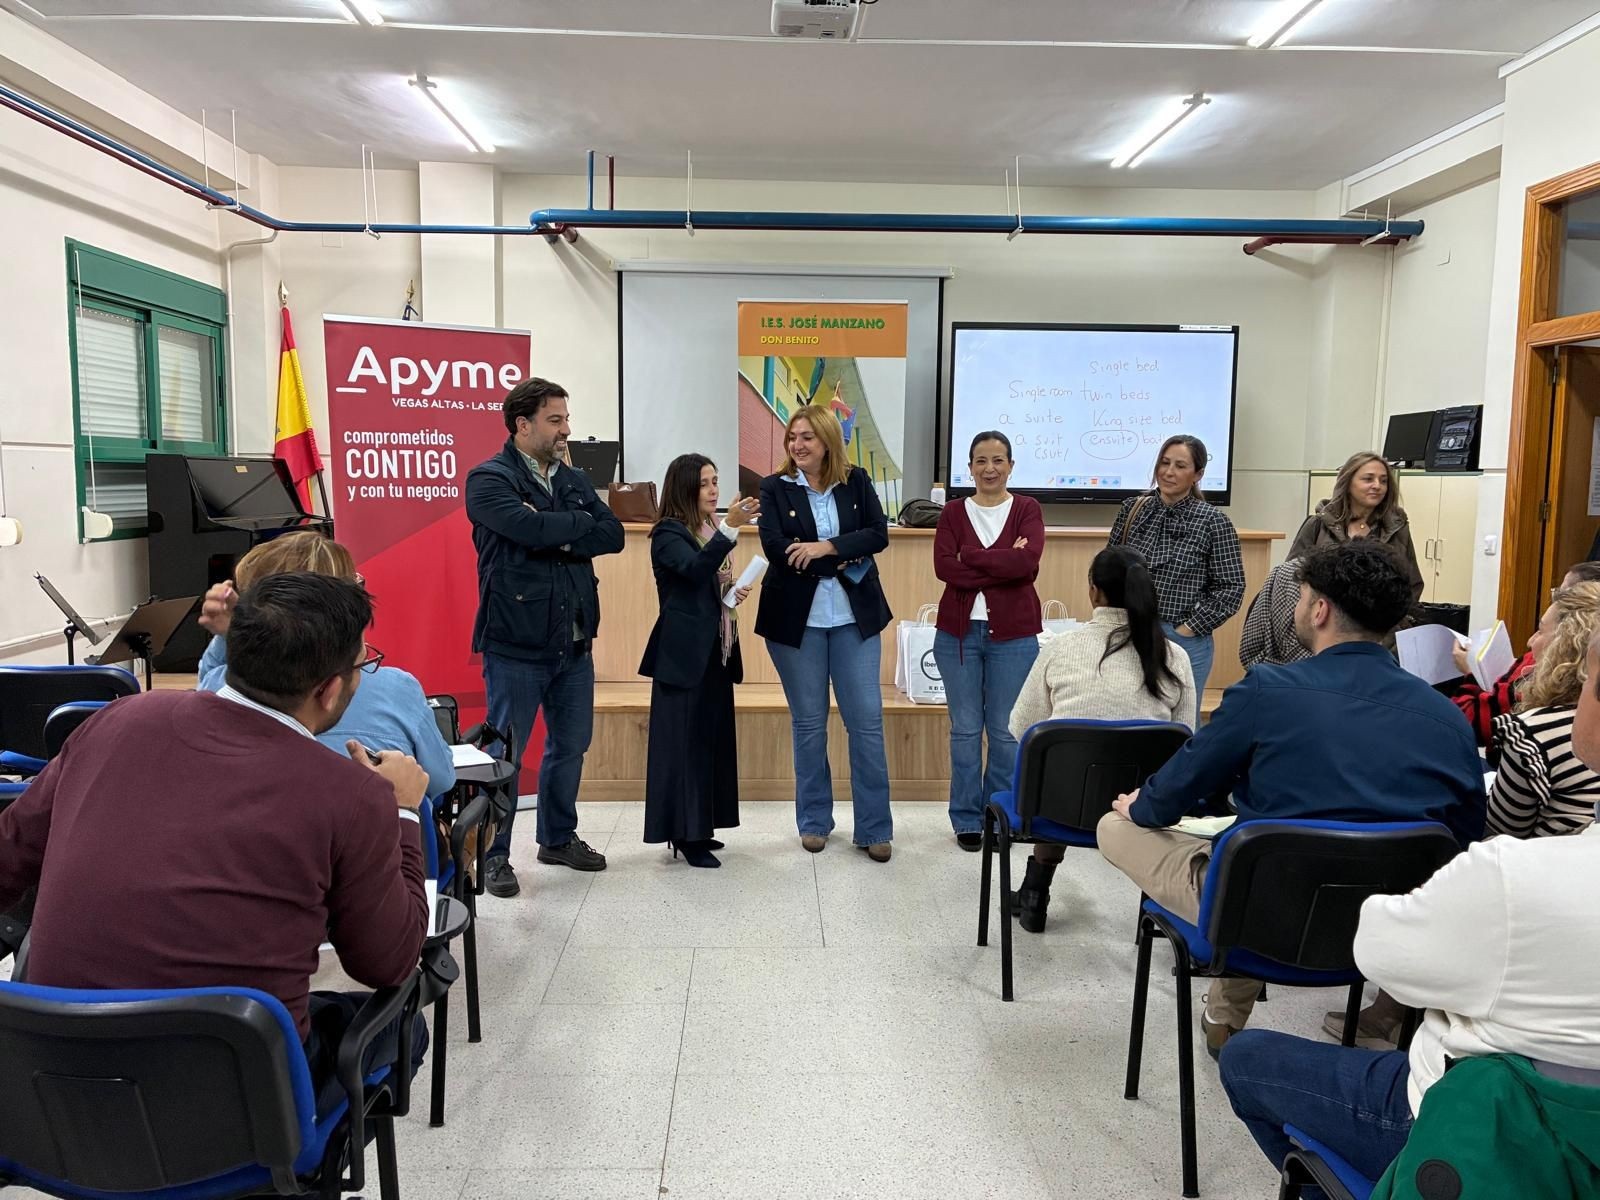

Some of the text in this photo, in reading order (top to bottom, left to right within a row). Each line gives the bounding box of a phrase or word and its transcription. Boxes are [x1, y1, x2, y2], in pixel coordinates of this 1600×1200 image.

[761, 315, 885, 329] I.E.S. JOSÉ MANZANO
[760, 336, 820, 344] DON BENITO
[347, 346, 522, 396] Apyme
[1136, 357, 1159, 372] bed
[1080, 379, 1151, 401] twin beds
[392, 398, 429, 408] VEGAS
[431, 400, 464, 410] ALTAS
[472, 401, 485, 411] LA
[999, 409, 1063, 425] a suite
[1093, 409, 1123, 430] King
[1161, 409, 1183, 425] bed
[343, 429, 454, 448] comprometidos
[1089, 432, 1134, 446] ensuite
[345, 448, 457, 479] CONTIGO
[347, 482, 459, 502] y con tu negocio
